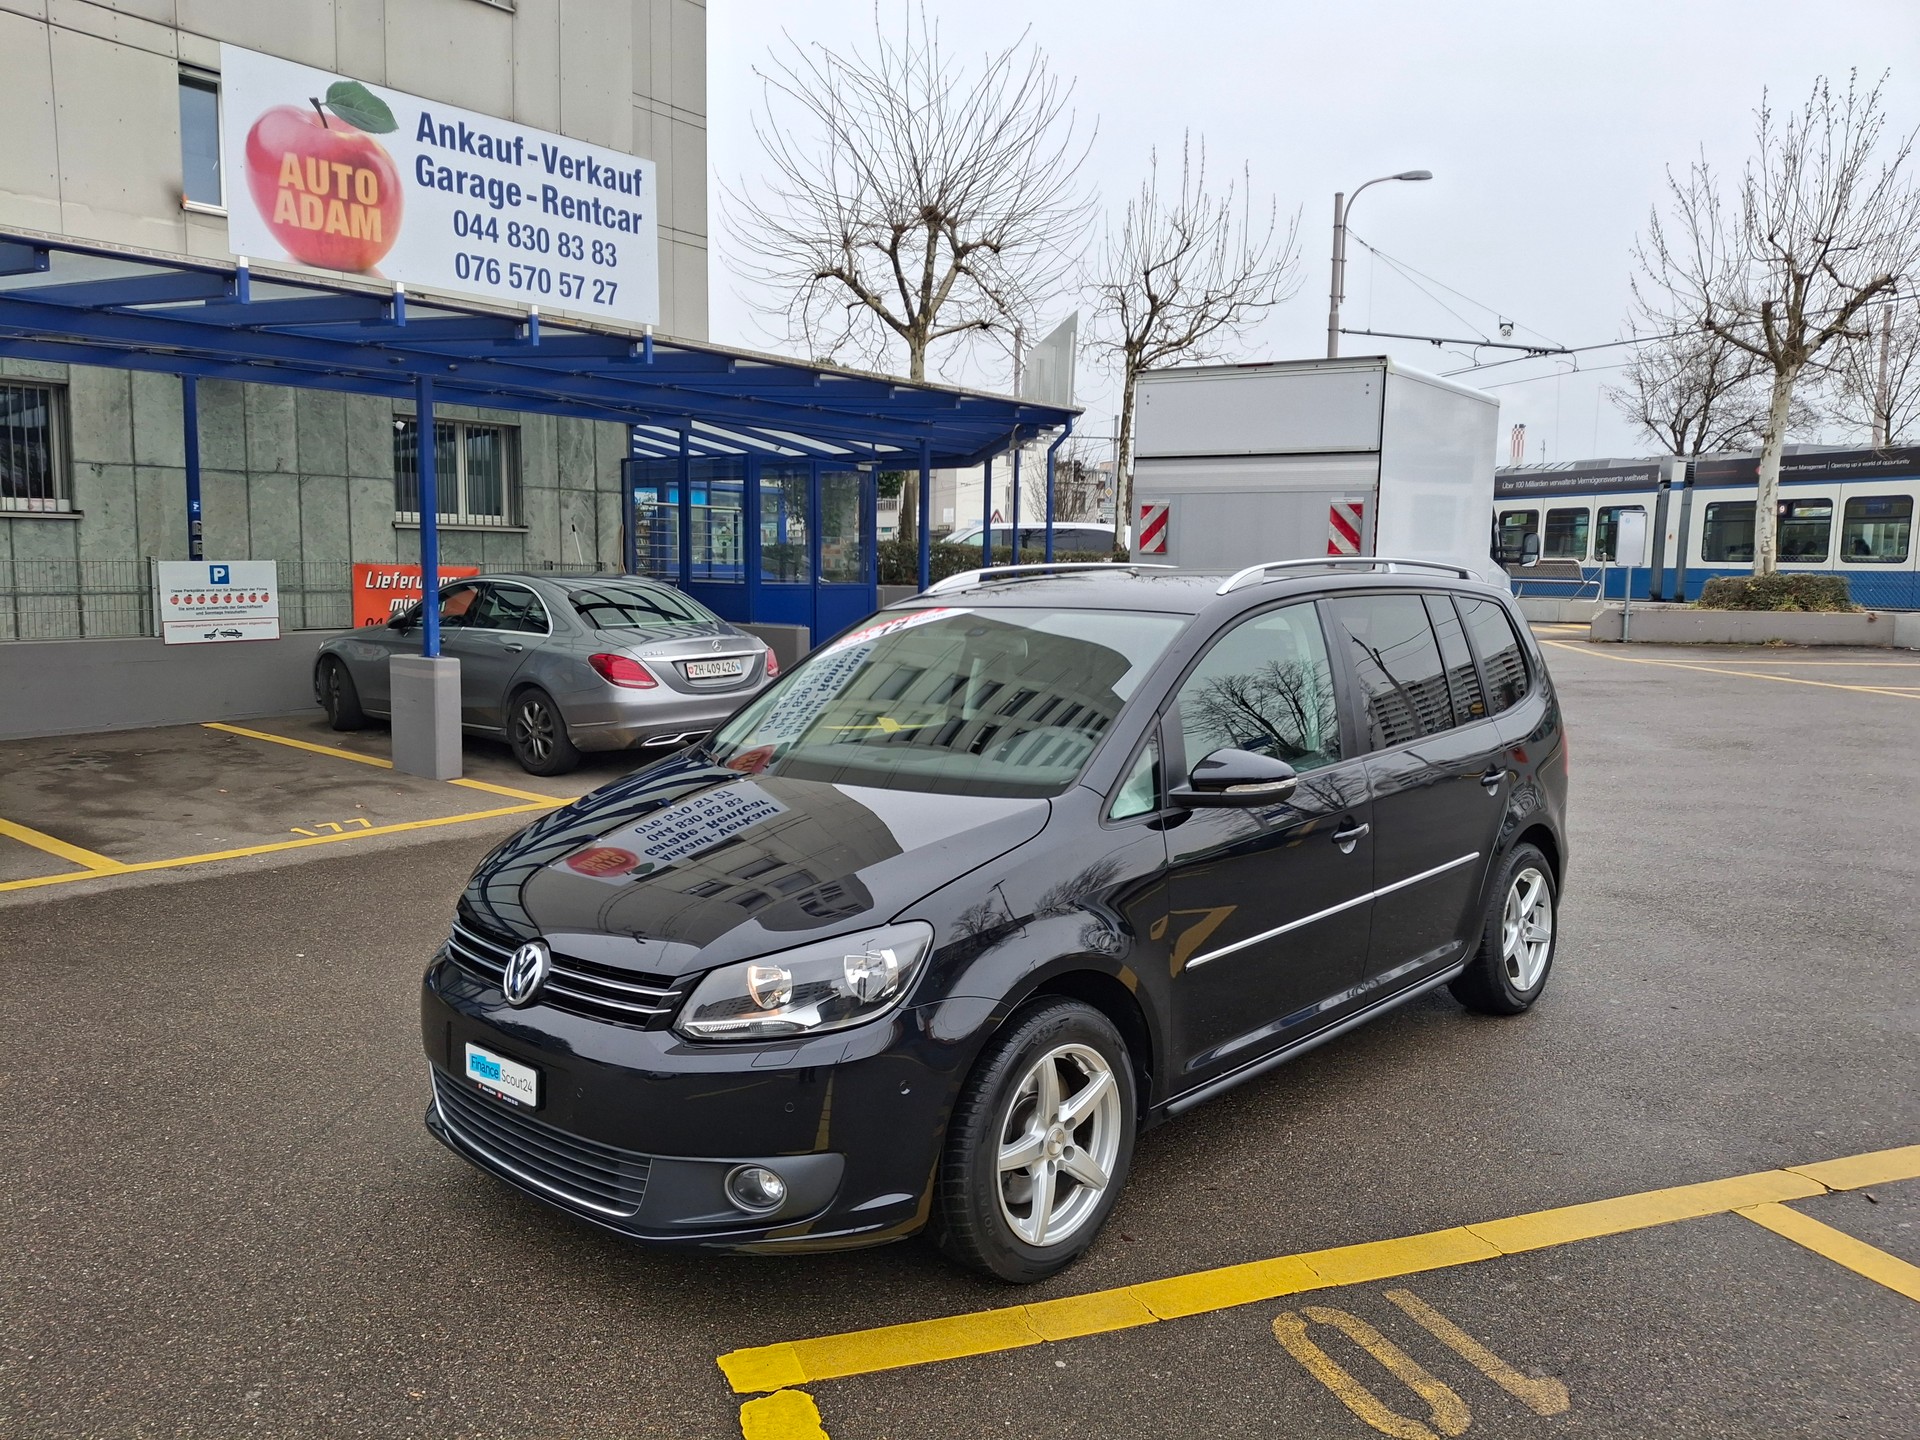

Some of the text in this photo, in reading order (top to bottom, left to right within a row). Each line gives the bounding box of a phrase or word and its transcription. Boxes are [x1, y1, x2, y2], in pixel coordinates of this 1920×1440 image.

[279, 152, 378, 206] AUTO
[273, 187, 382, 243] ADAM
[453, 209, 618, 268] 044 830 83 83
[455, 252, 618, 306] 076 570 57 27
[1502, 328, 1512, 337] 36
[1830, 461, 1851, 469] Opening
[1502, 482, 1514, 490] Über
[1524, 480, 1549, 488] Milliarden
[1624, 473, 1650, 482] weltweit
[213, 567, 226, 582] P
[365, 571, 462, 589] Liefer
[290, 818, 372, 836] 177
[471, 1055, 499, 1079] Finance
[501, 1069, 533, 1093] Scout24
